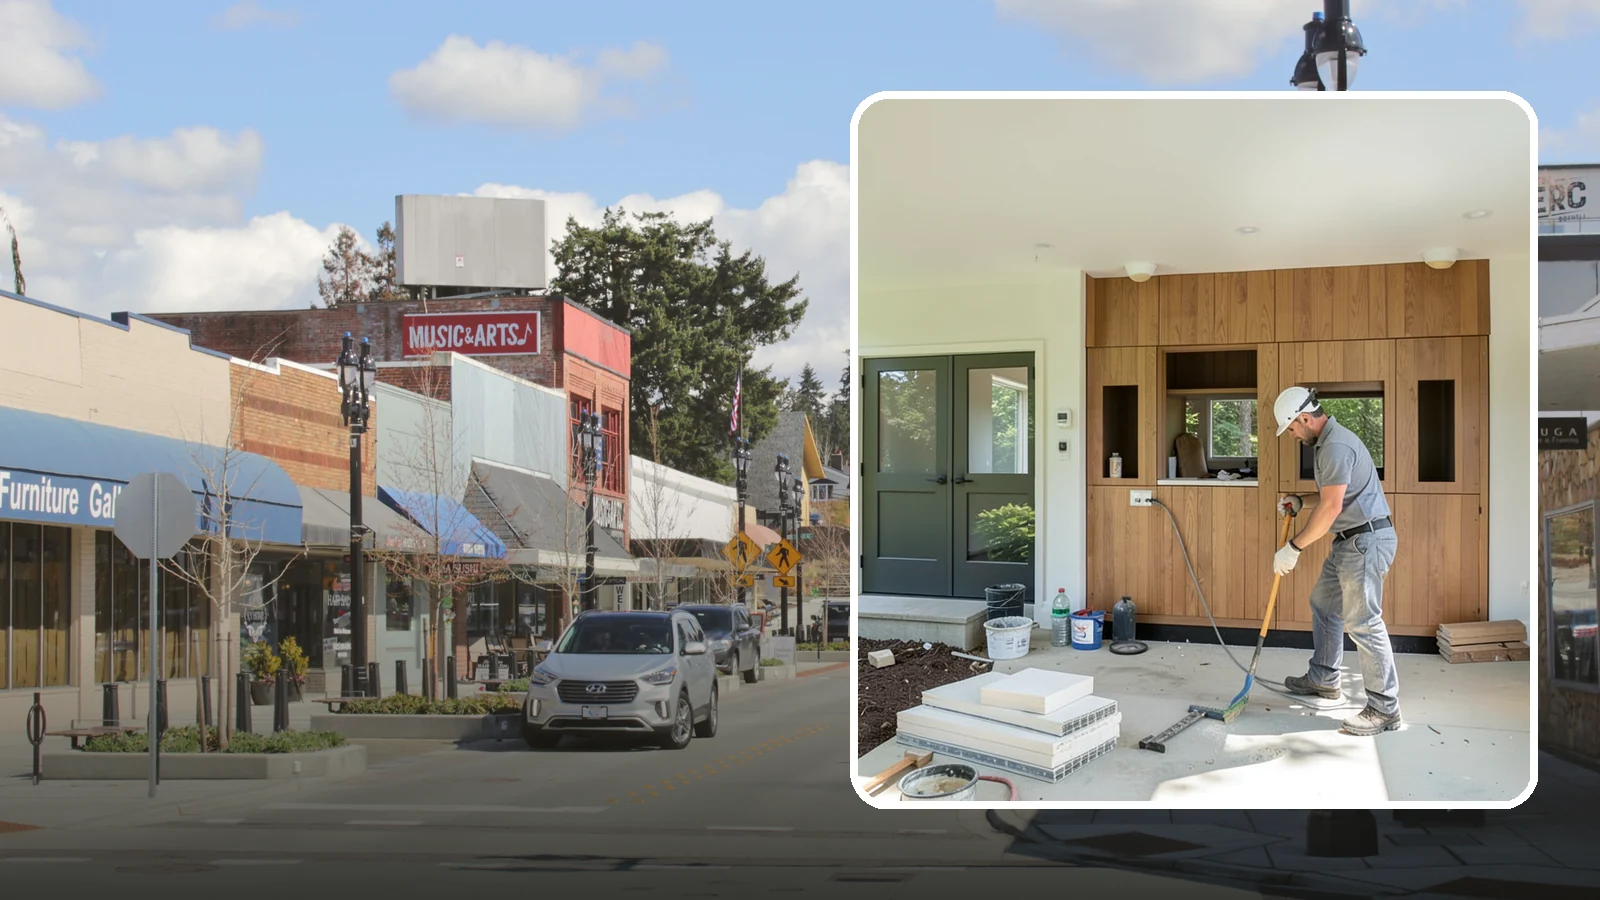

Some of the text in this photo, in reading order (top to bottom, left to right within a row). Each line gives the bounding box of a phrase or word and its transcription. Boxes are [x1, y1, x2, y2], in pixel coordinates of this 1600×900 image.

[0, 471, 121, 519] Furniture Gal
[452, 563, 479, 574] SUSHI
